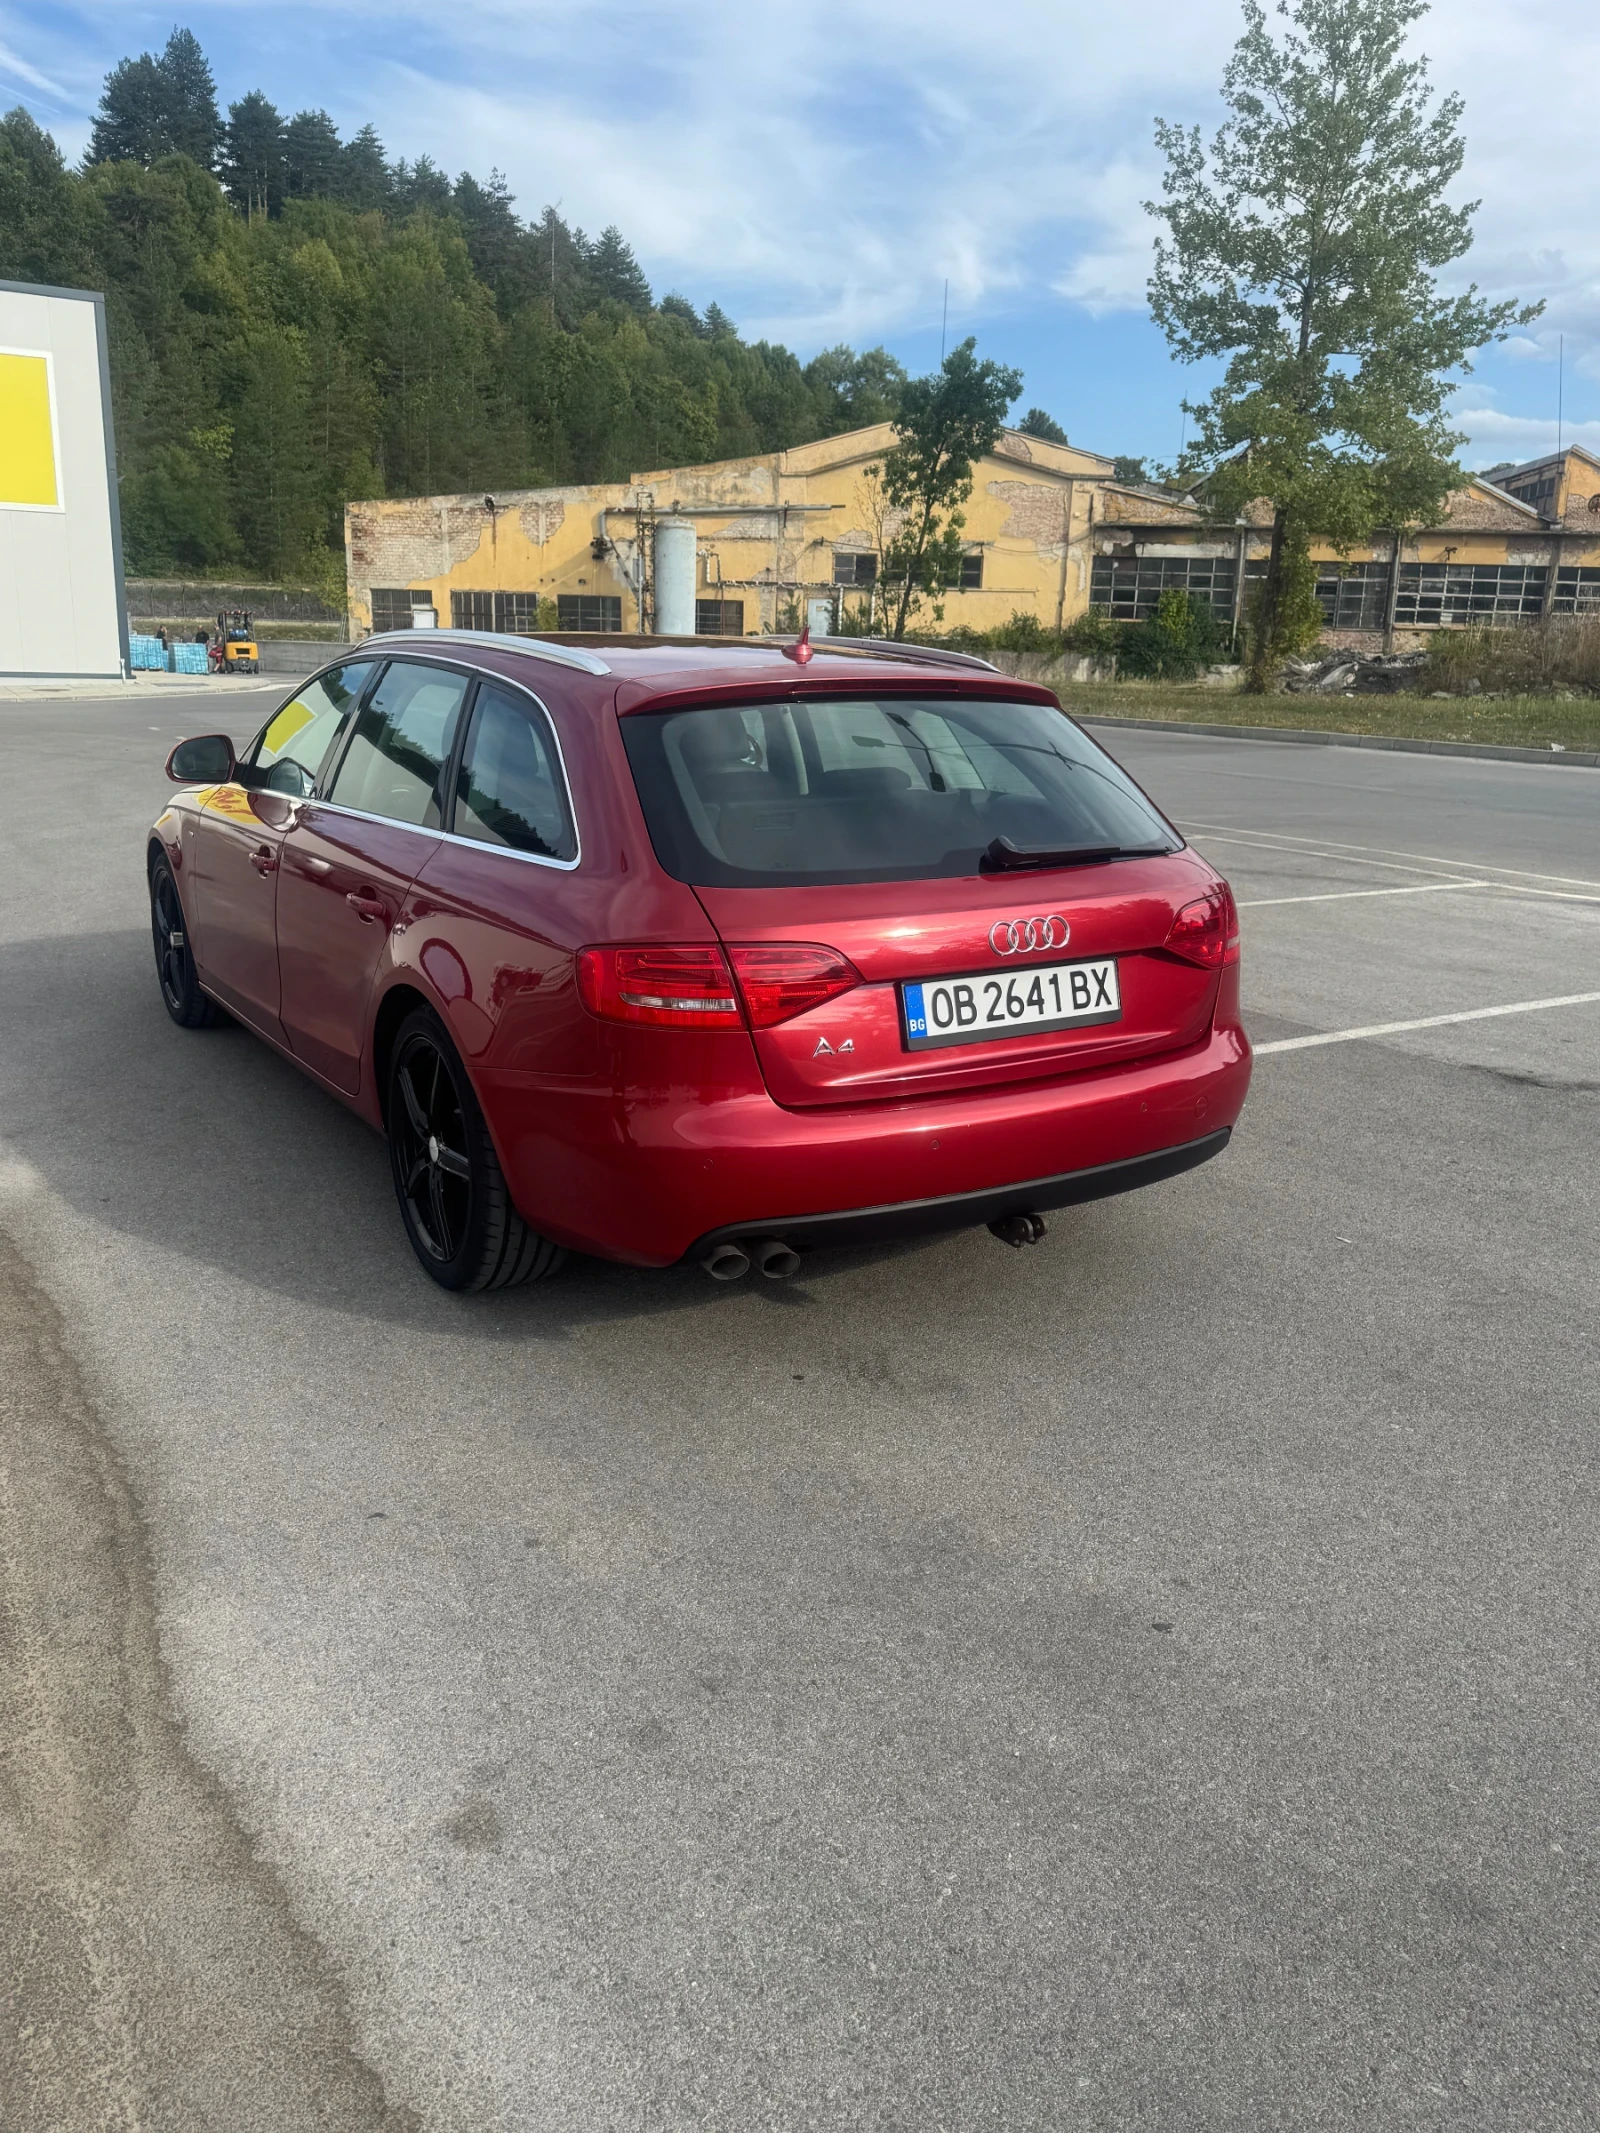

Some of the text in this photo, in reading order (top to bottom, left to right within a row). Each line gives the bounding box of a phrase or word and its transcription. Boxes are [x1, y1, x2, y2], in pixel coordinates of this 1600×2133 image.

[931, 967, 1112, 1028] OB 2641 BX
[909, 1018, 925, 1032] BG
[812, 1036, 855, 1058] A4
